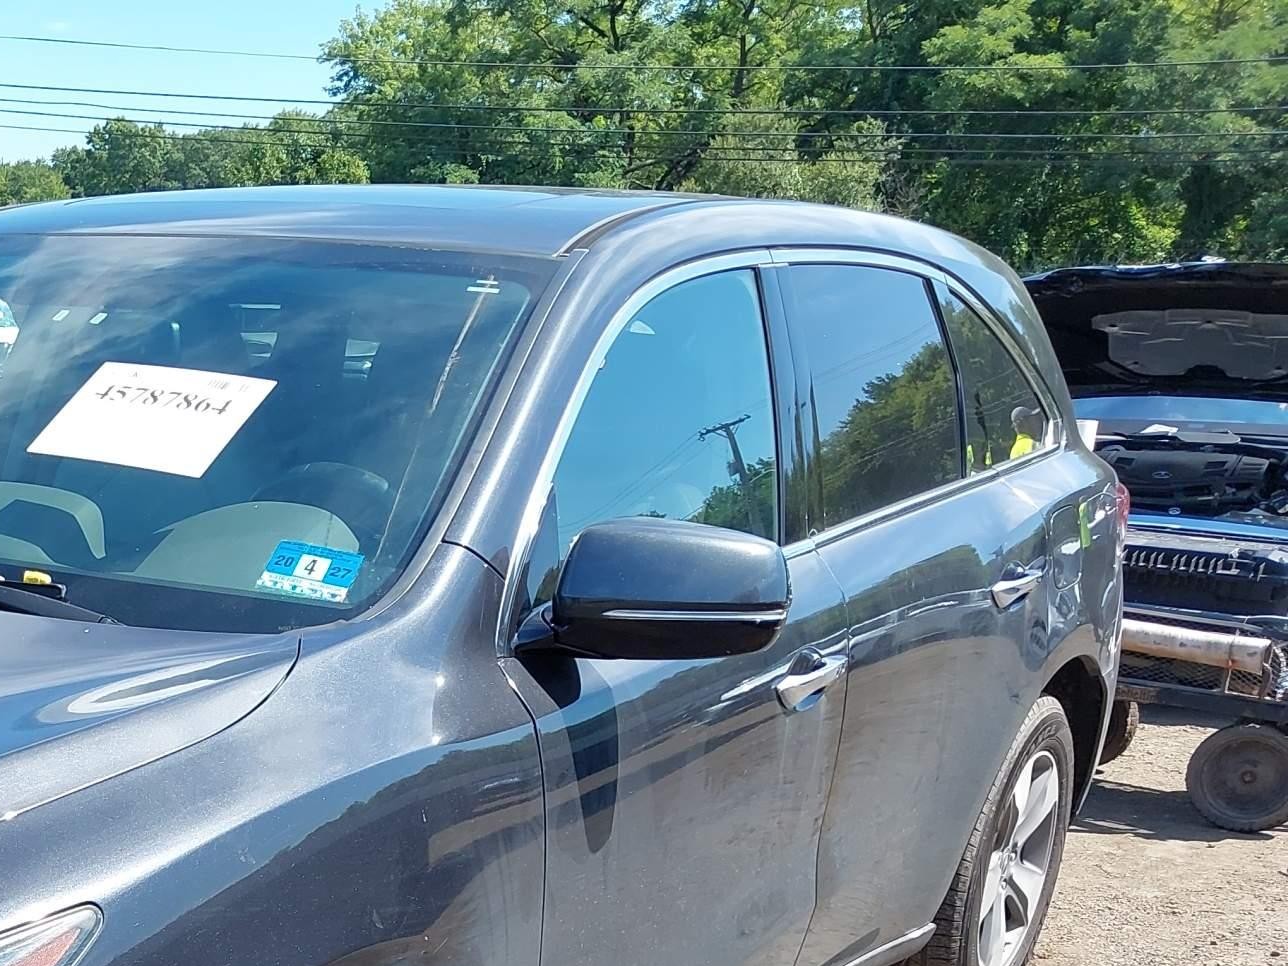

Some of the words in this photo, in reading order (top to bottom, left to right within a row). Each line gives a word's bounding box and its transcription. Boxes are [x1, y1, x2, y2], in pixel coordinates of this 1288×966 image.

[95, 384, 233, 415] 45787864
[274, 554, 295, 568] 20
[304, 559, 318, 575] 4
[329, 566, 353, 579] 27
